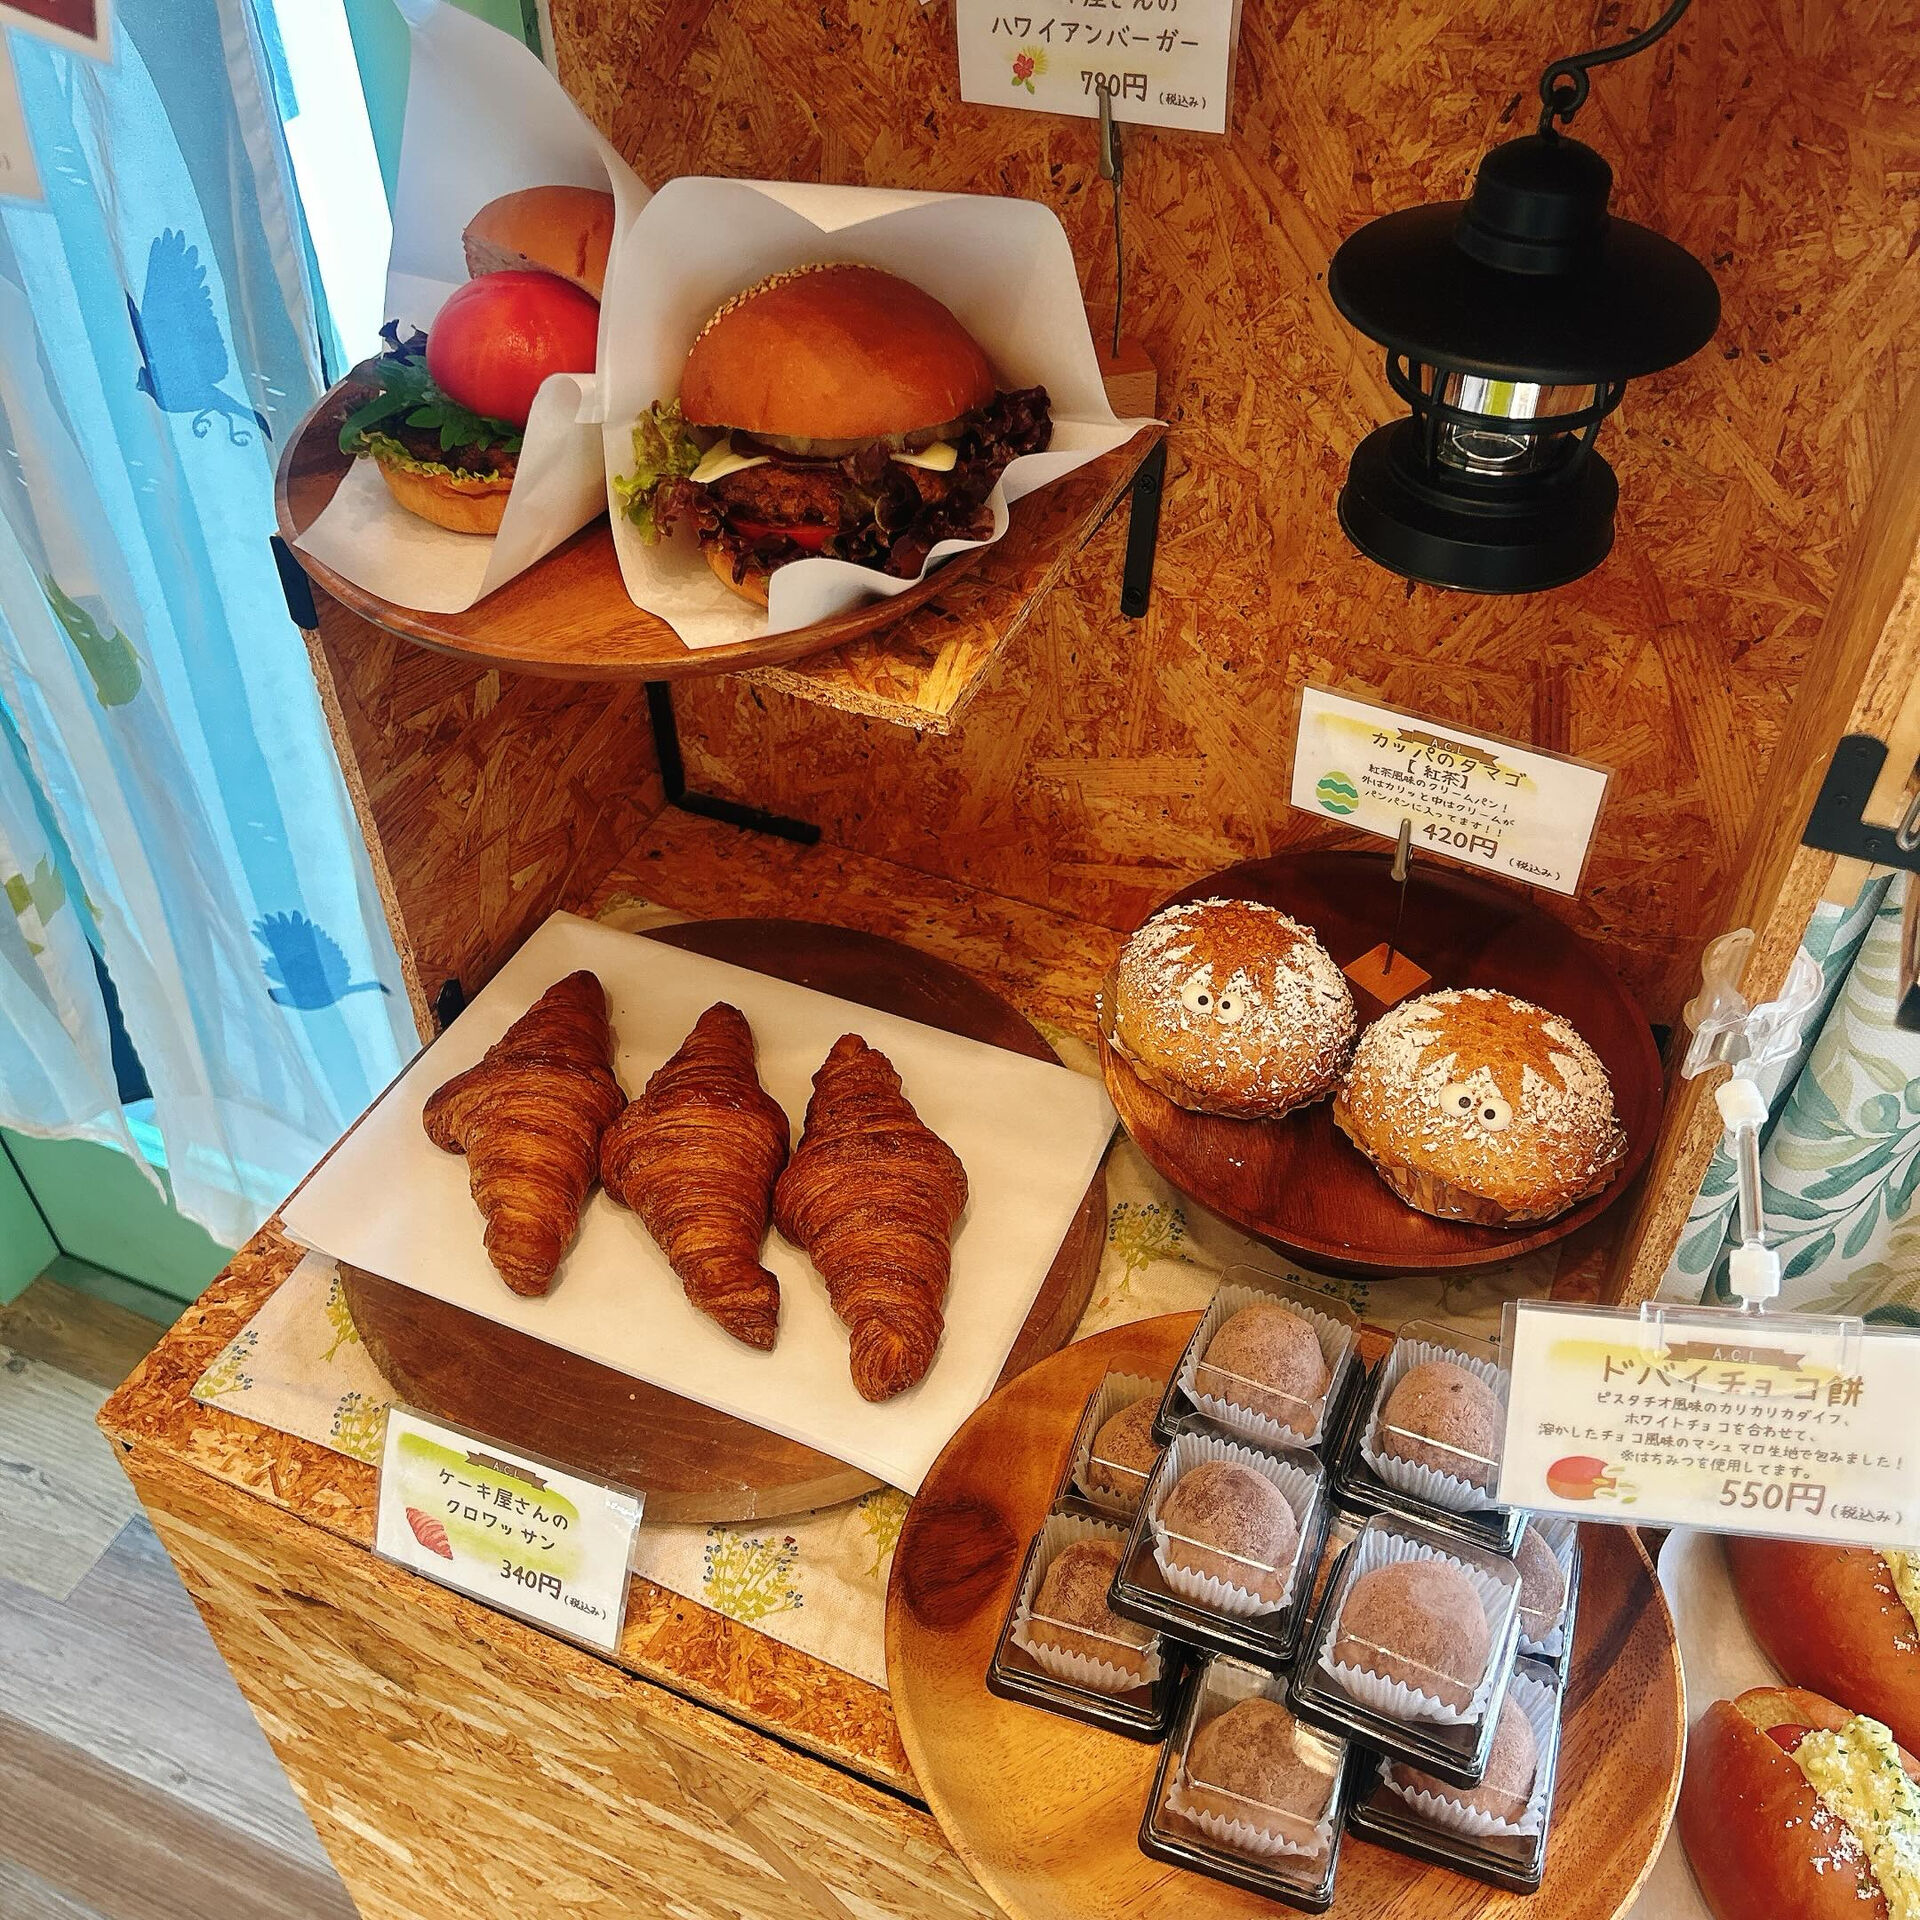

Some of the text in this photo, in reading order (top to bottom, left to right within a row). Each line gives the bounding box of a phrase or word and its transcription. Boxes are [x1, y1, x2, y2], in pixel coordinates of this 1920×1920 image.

[991, 16, 1198, 52] ハワイアンバーガー
[1160, 92, 1206, 109] （税込み）
[1372, 732, 1528, 788] カッパのタマゴ
[1407, 759, 1469, 789] 【紅茶】
[1362, 775, 1515, 826] 外はカリッと中はクリームが
[1423, 824, 1560, 881] 420円 （税込み）
[1603, 1355, 1864, 1407] ドバイチョコ餅
[1598, 1391, 1853, 1427] ピスタチオ風味のカリカリカダイフ、
[1624, 1413, 1818, 1442] ホワイトチョコを合わせて、
[439, 1468, 568, 1530] ケーキ屋さんの
[1719, 1479, 1903, 1525] 550円 （税込み）
[446, 1500, 555, 1550] クロワッサン
[501, 1560, 607, 1621] 340円 （税込み）
